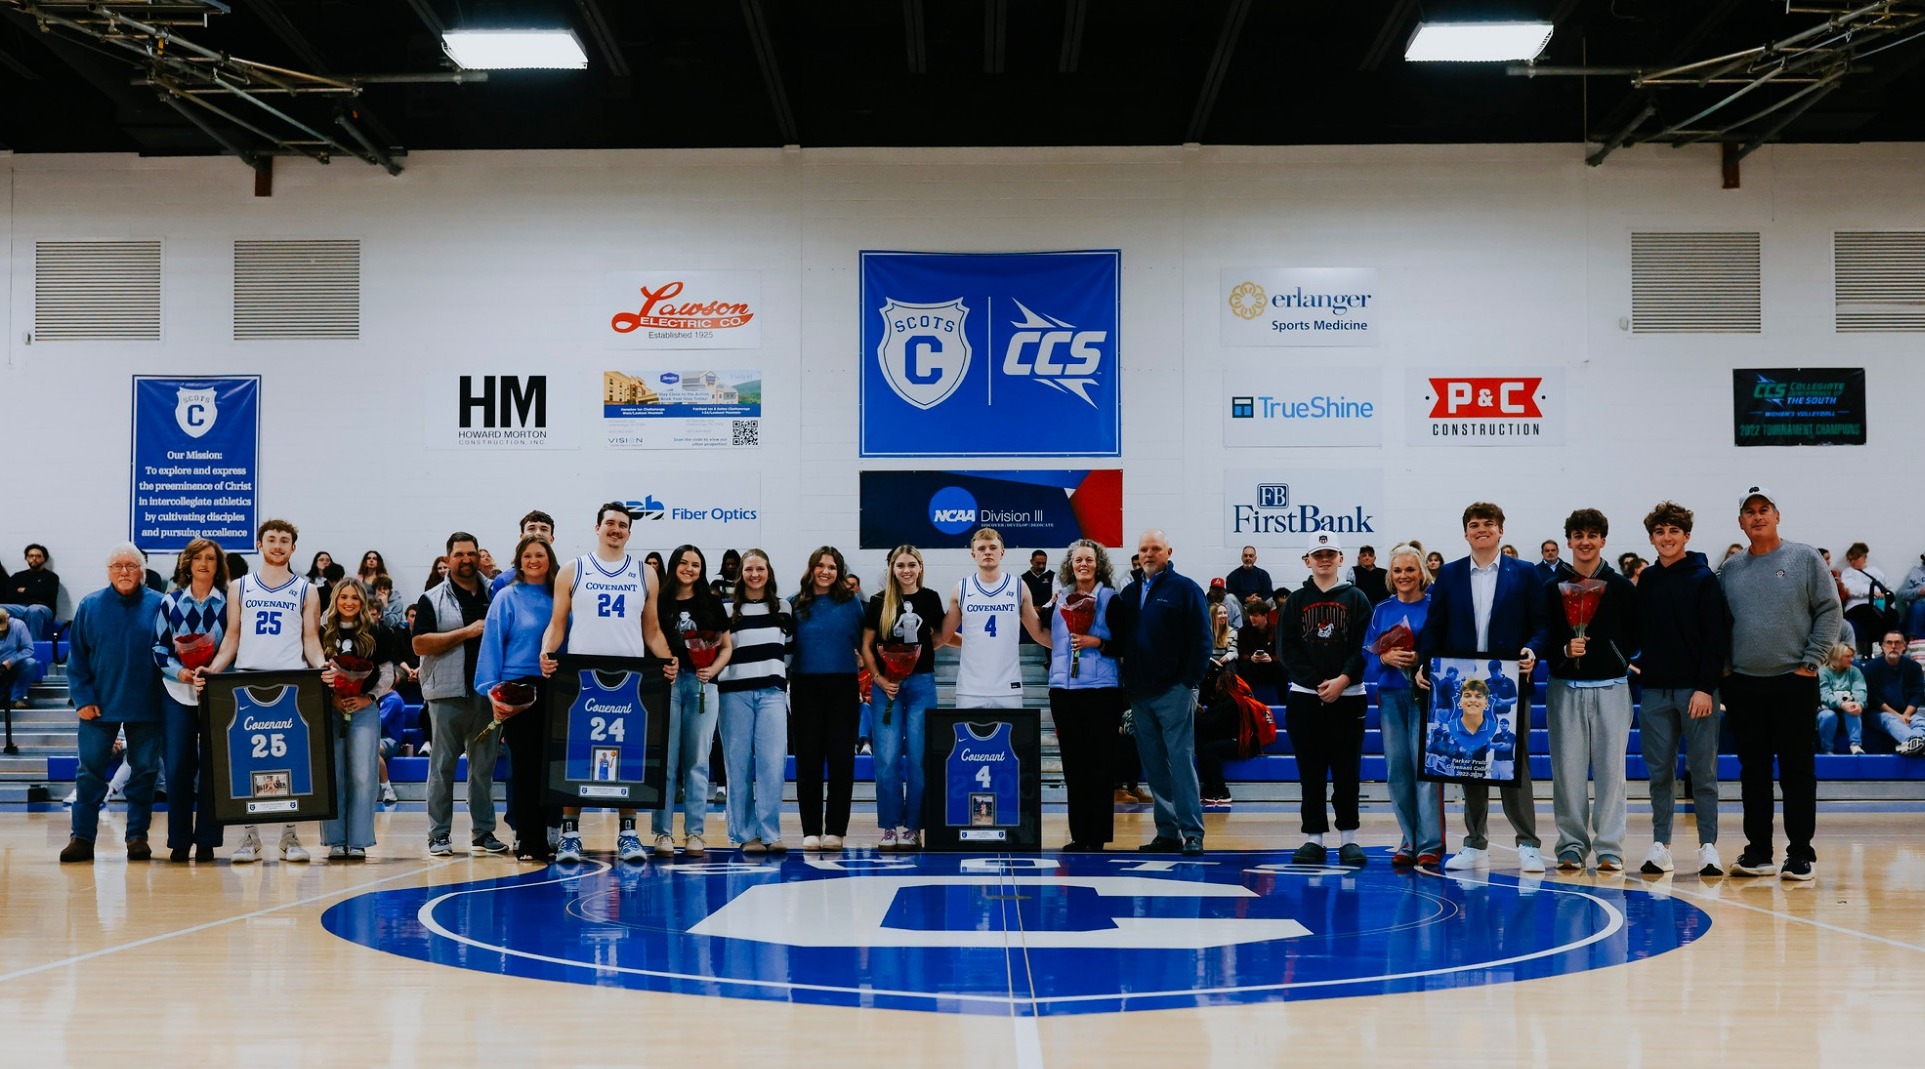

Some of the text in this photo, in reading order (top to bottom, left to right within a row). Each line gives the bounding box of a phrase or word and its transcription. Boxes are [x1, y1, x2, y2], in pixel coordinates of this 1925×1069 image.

[611, 281, 752, 332] Lawson
[1271, 287, 1372, 316] erlanger
[640, 316, 744, 328] ELECTRIC CO.
[894, 316, 954, 333] SCOTS
[1272, 320, 1368, 332] Sports Medicine
[648, 331, 713, 340] Established 1925
[904, 335, 943, 385] C
[1002, 330, 1108, 376] CCS
[1754, 383, 1787, 398] CCS
[182, 395, 211, 404] SCOTS
[459, 376, 546, 428] HM
[1258, 396, 1374, 418] TrueShine
[187, 404, 205, 426] C
[1432, 423, 1540, 436] CONSTRUCTION
[1740, 424, 1860, 436] 2022 TOURNAMENT CHAMPIONS
[166, 450, 222, 460] Our Mission:
[144, 466, 246, 477] To explore and express
[139, 482, 252, 492] the preeminence of Christ
[138, 497, 252, 508] in intercollegiate athletics
[1260, 487, 1286, 506] FB
[144, 512, 244, 523] by cultivating disciples
[672, 508, 757, 523] Fiber Optics
[934, 509, 976, 522] NCAA
[980, 510, 1043, 522] Division III
[1232, 504, 1374, 533] FirstBank
[141, 528, 248, 538] and pursuing excellence
[586, 582, 638, 592] COVENANT
[246, 600, 296, 612] COVENANT
[598, 594, 626, 618] 24
[967, 604, 1015, 613] COVENANT
[256, 610, 282, 635] 25
[984, 615, 996, 637] 4
[584, 698, 632, 714] Covenant
[244, 716, 293, 731] Covenant
[590, 716, 626, 742] 24
[251, 734, 287, 758] 25
[961, 748, 1005, 763] Covenant
[975, 766, 991, 788] 4
[686, 876, 1314, 948] C
